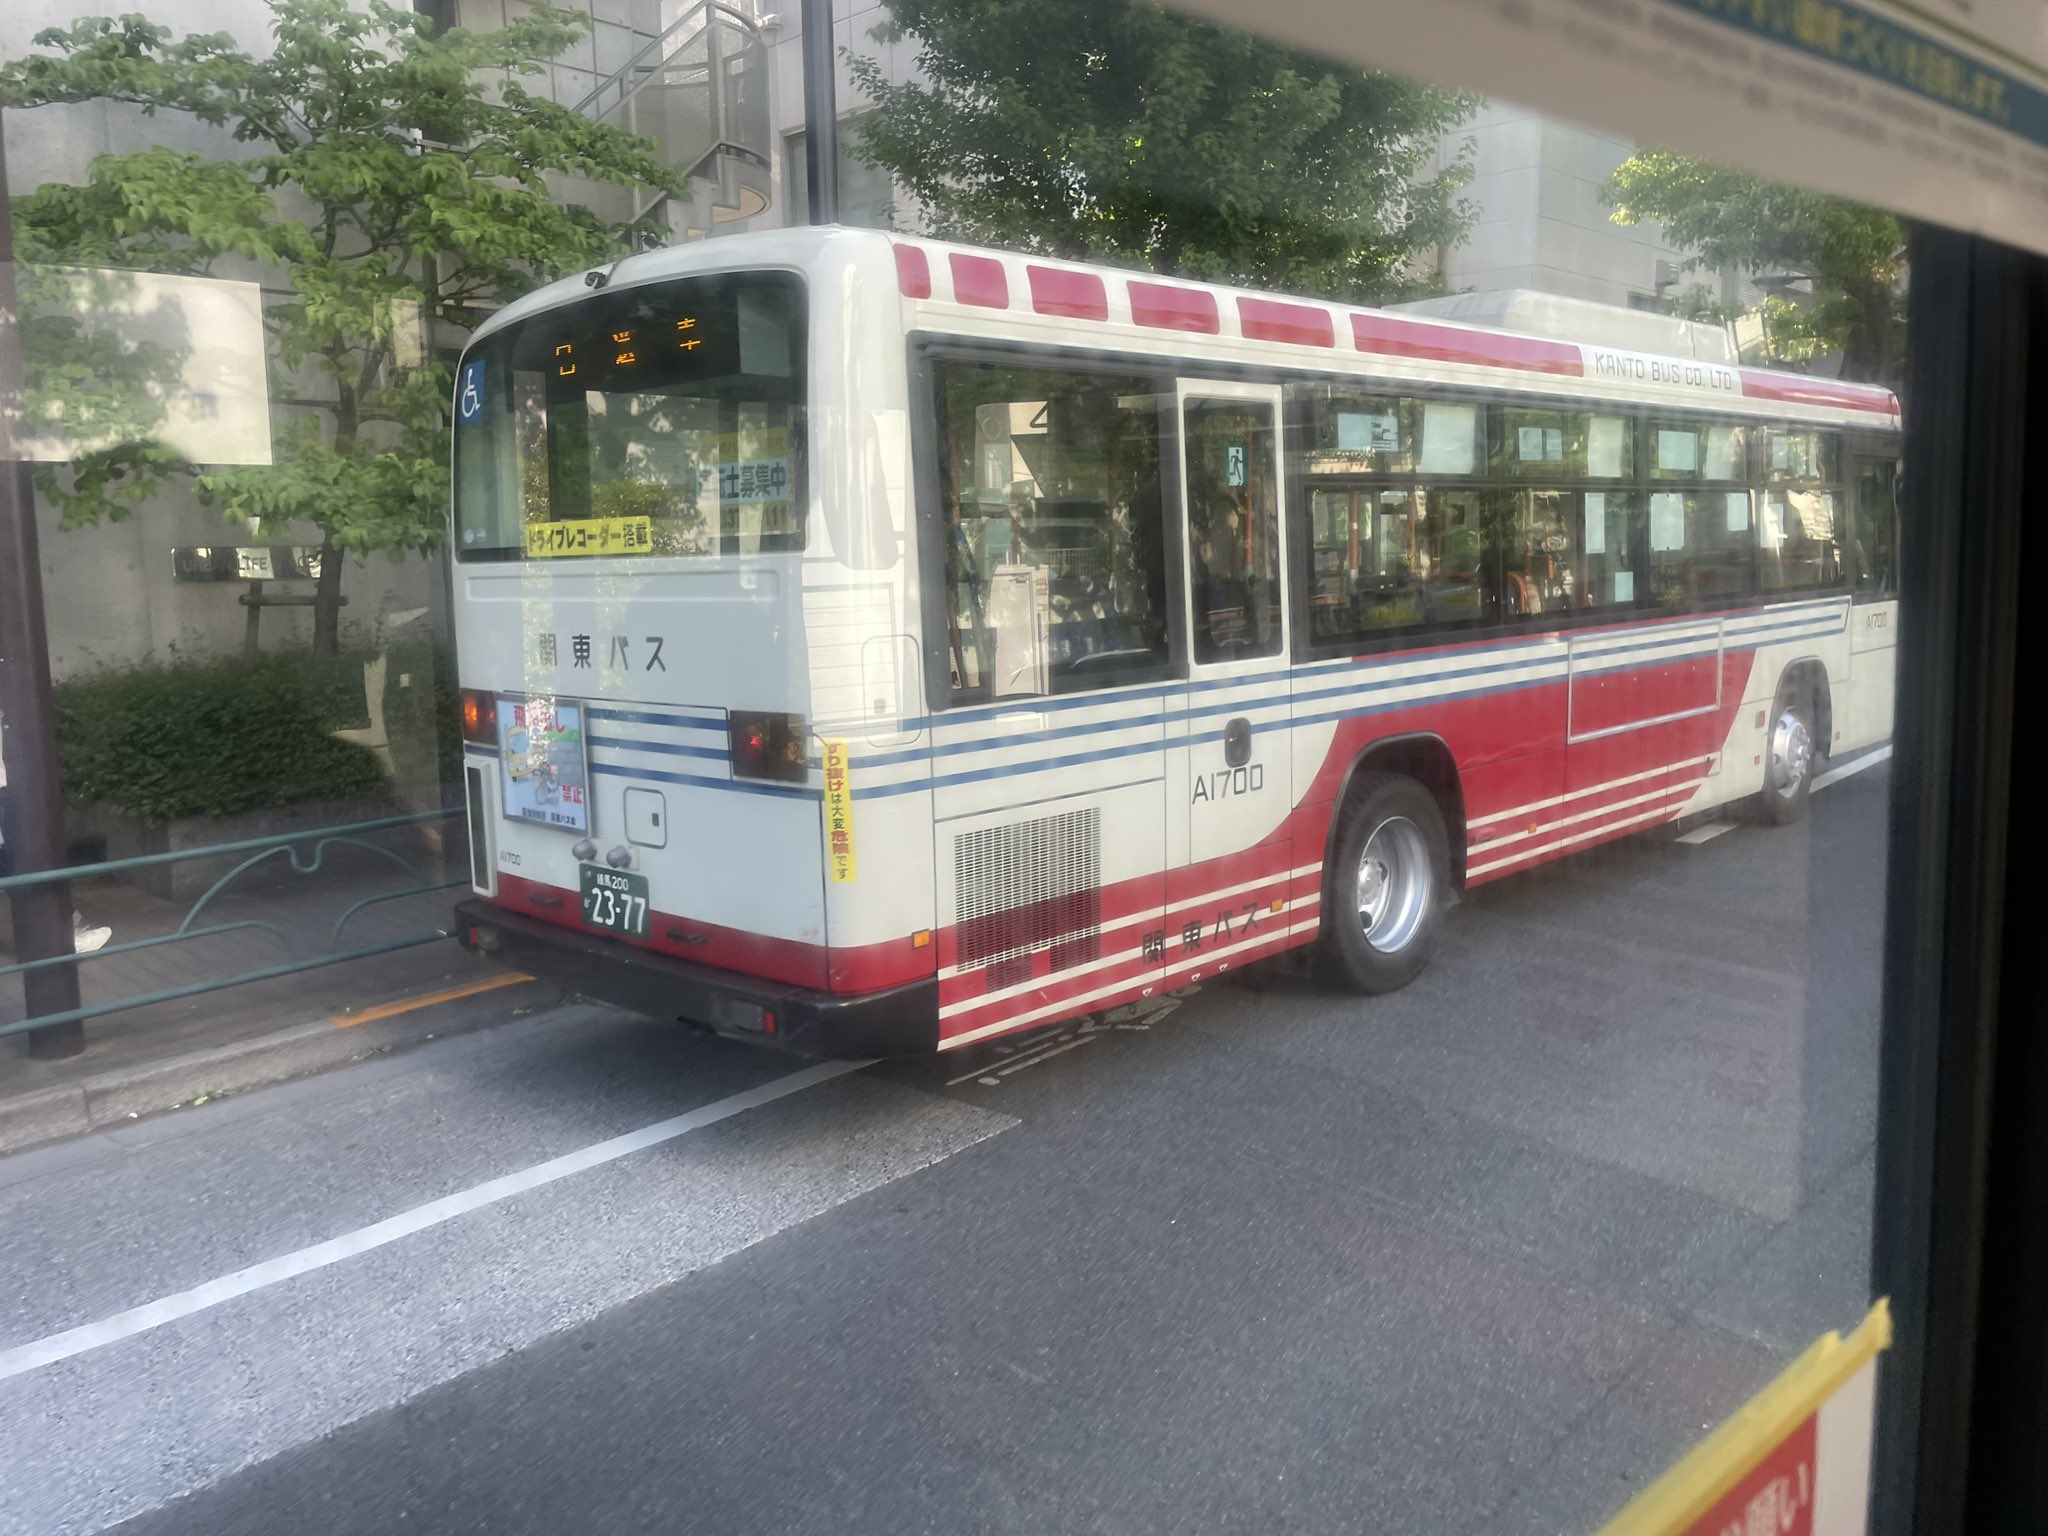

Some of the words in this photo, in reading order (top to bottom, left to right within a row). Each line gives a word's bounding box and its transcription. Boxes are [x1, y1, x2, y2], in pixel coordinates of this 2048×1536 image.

[1594, 352, 1645, 379] KANTO
[1651, 361, 1680, 384] BUS
[528, 522, 649, 552] ドライブレコーダー搭載
[539, 633, 667, 672] 関東バス
[1192, 763, 1263, 805] A1700
[825, 741, 850, 880] すり抜けは大変危険です
[1142, 902, 1259, 965] 関東バス
